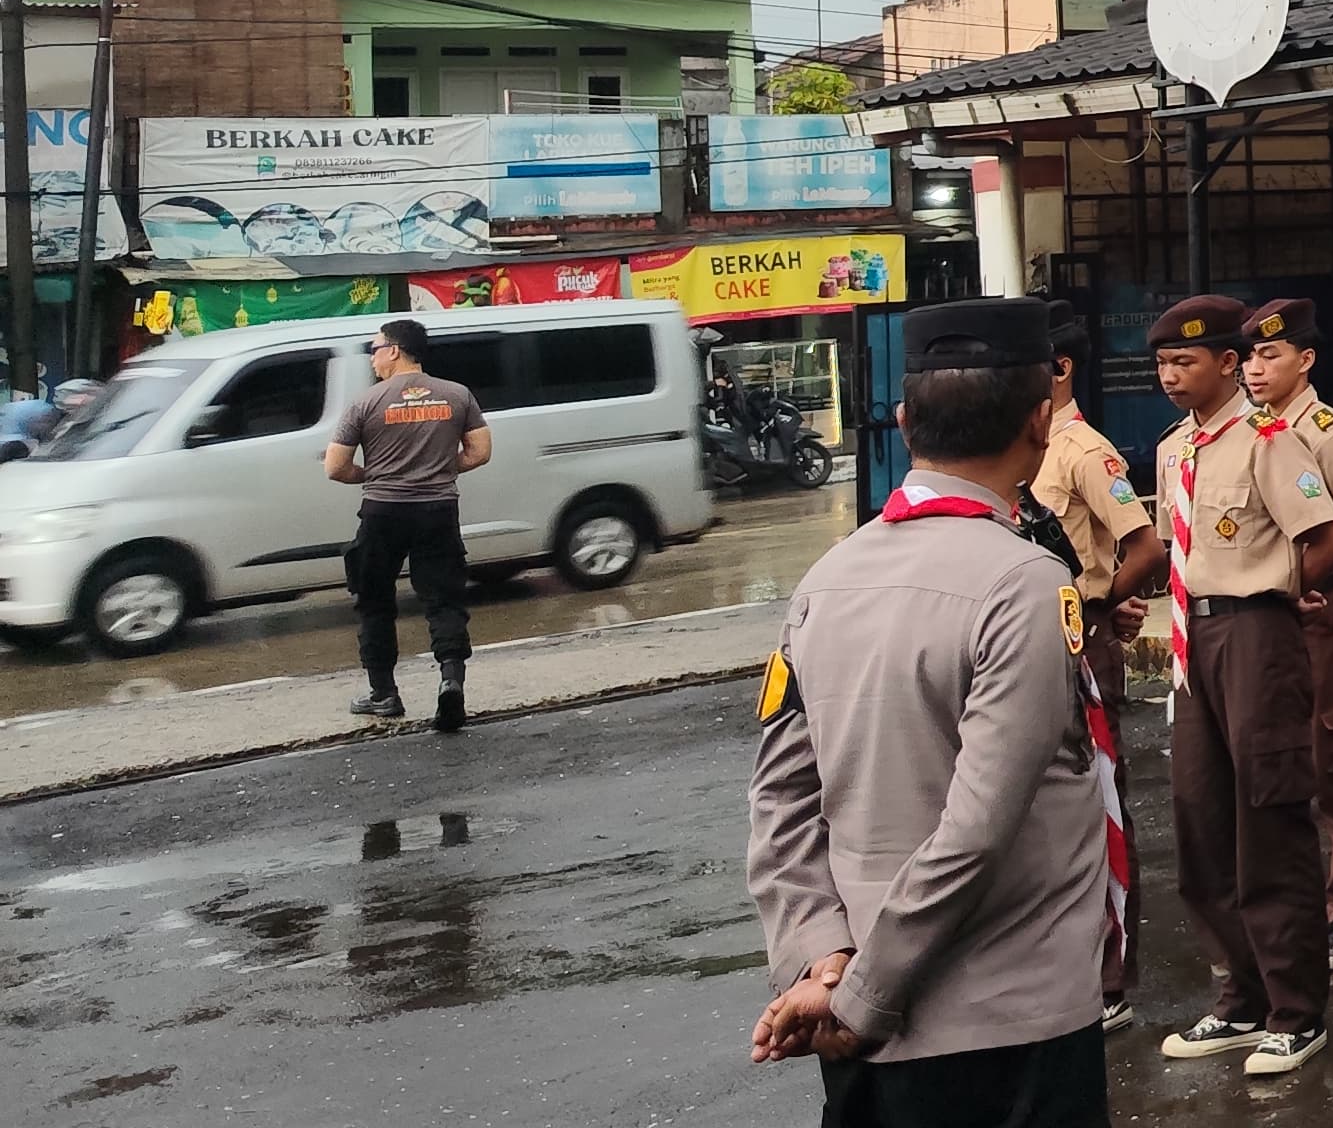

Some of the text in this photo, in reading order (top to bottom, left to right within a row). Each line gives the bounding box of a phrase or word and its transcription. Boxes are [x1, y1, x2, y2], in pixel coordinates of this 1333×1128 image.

[205, 127, 435, 150] BERKAH CAKE
[532, 132, 625, 148] TOKO KUE
[759, 137, 836, 153] WARUNG
[820, 153, 877, 175] IPEH
[710, 250, 802, 276] BERKAH
[714, 277, 771, 301] CAKE
